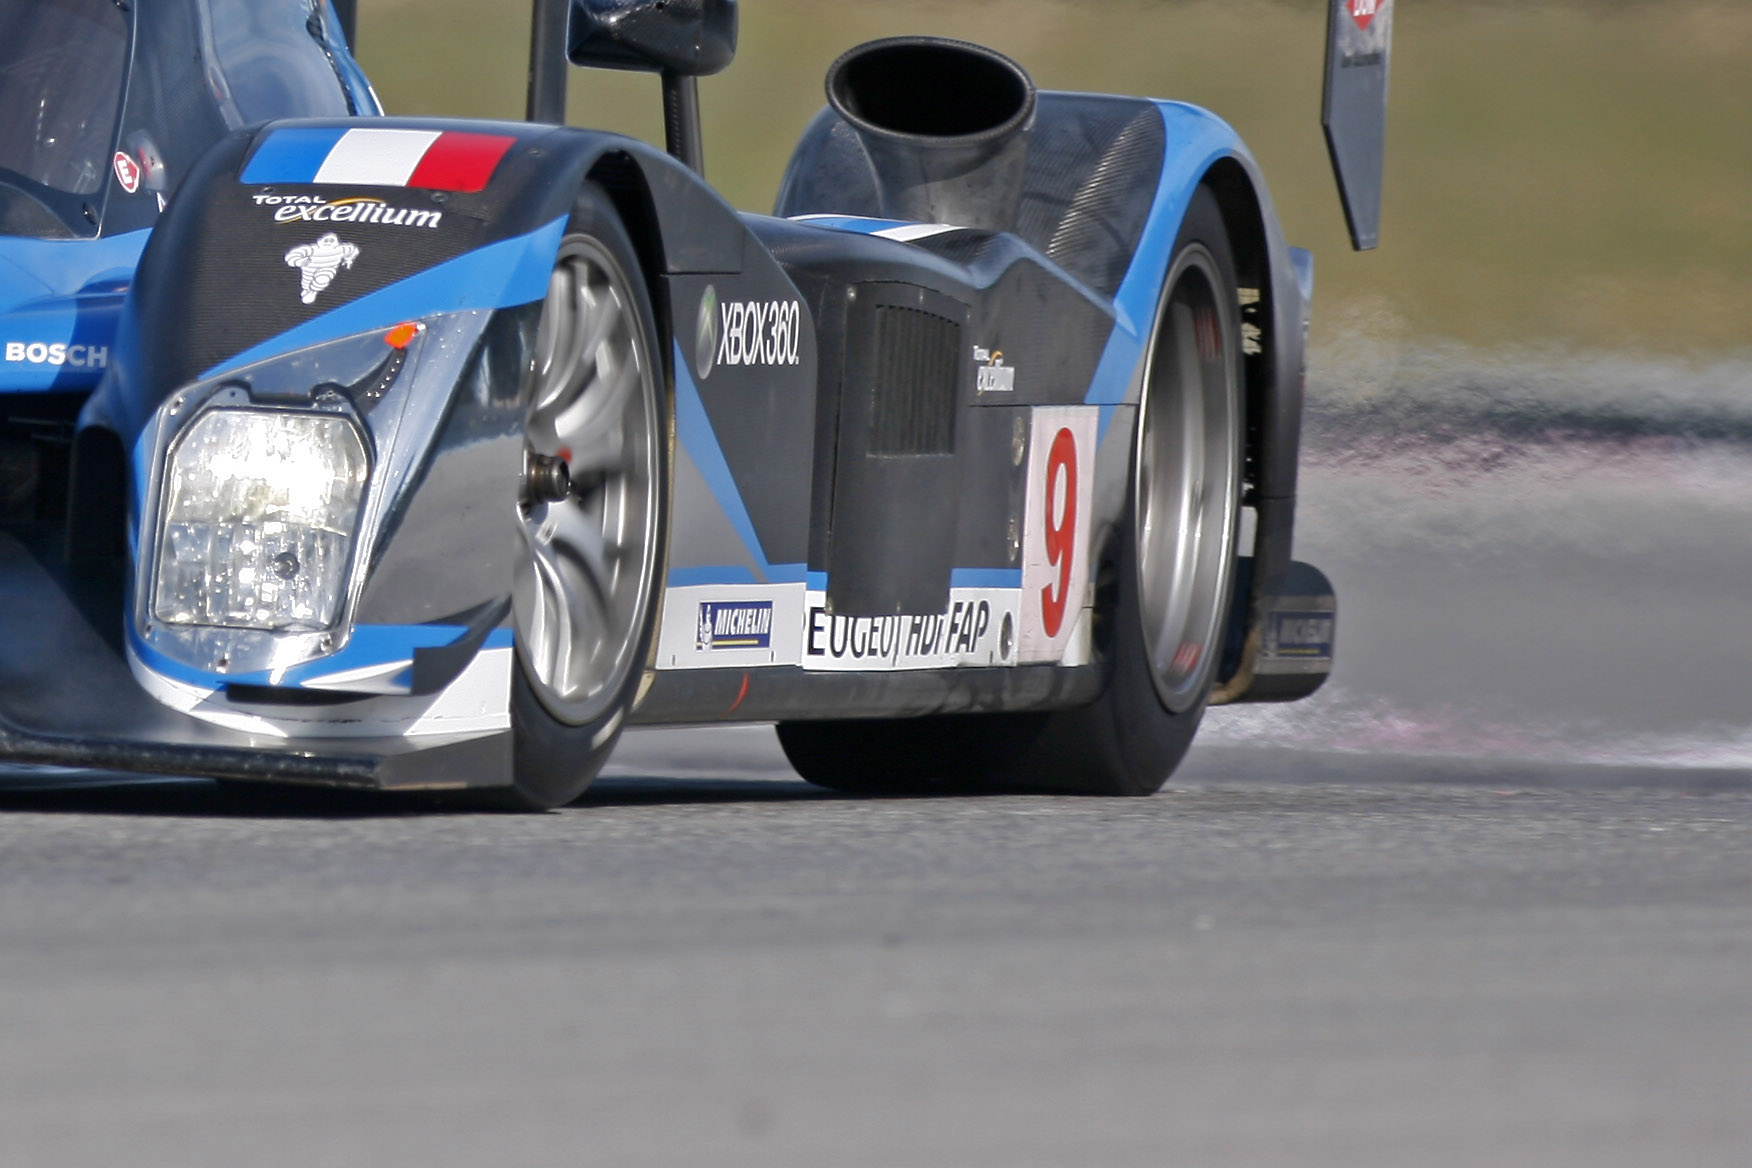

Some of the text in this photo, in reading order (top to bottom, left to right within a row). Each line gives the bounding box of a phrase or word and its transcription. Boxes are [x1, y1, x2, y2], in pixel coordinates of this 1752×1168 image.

[253, 195, 327, 205] TOTAL
[274, 202, 442, 228] excellium
[5, 342, 107, 368] BOSCH
[1041, 427, 1079, 638] 9
[714, 608, 771, 635] MICHELIN
[945, 600, 990, 653] FAP
